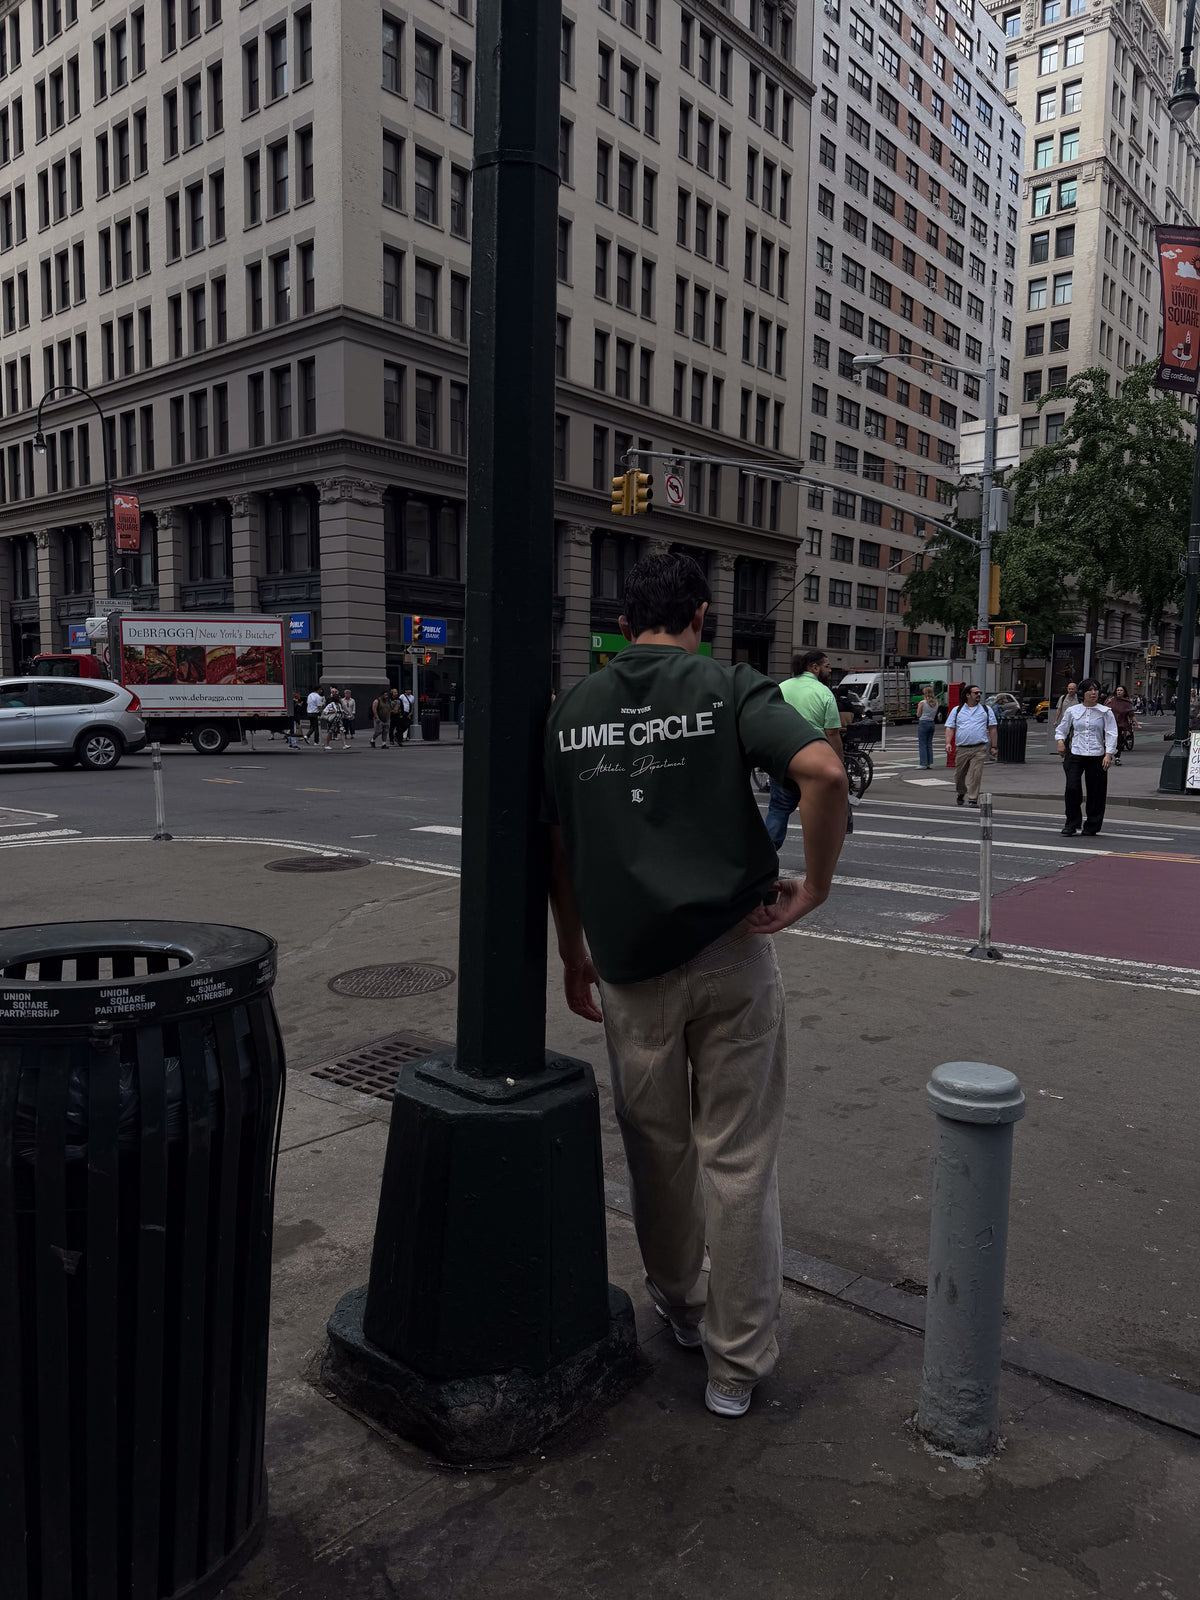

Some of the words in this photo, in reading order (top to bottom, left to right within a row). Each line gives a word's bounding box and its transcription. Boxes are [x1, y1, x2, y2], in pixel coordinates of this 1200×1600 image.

[1171, 292, 1198, 311] UNION
[1168, 306, 1200, 328] SQUARE
[1170, 373, 1195, 383] conEdison
[199, 629, 217, 639] New
[219, 630, 243, 639] York's
[245, 630, 275, 640] Butcher
[169, 693, 243, 702] www.debragga.com
[637, 705, 652, 714] YORK
[558, 722, 625, 753] LUME
[628, 711, 716, 747] CIRCLE
[578, 754, 626, 782] Athletic
[629, 754, 687, 778] Department
[99, 988, 130, 998] UNION
[198, 981, 227, 994] SQUARE
[3, 992, 32, 1001] UNION
[109, 994, 147, 1006] SQUARE
[185, 988, 234, 1005] PARTNERSHIP
[12, 1001, 49, 1010] SQUARE
[94, 1001, 157, 1015] PARTNERSHIP
[0, 1009, 60, 1018] PARTNERSHIP
